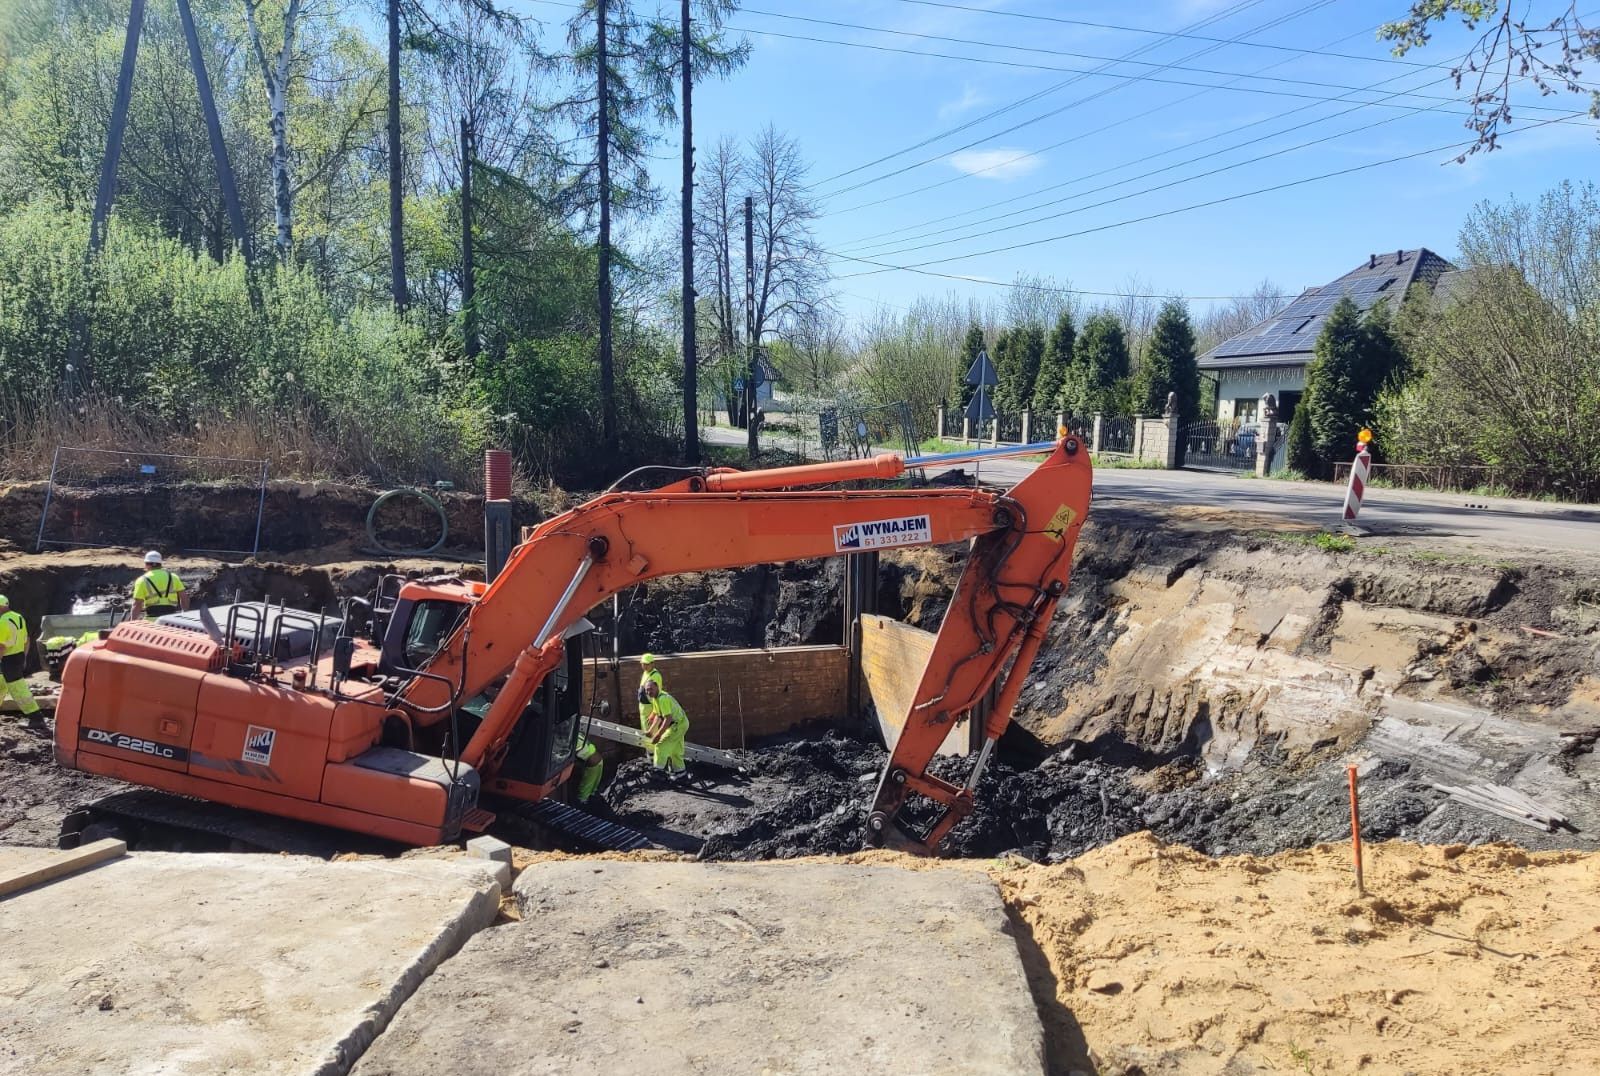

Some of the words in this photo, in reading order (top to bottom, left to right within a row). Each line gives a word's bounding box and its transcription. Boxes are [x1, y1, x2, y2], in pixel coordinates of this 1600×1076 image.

[862, 518, 926, 536] WYNAJEM
[880, 535, 898, 545] 333
[901, 533, 919, 543] 222
[87, 729, 120, 743] DX
